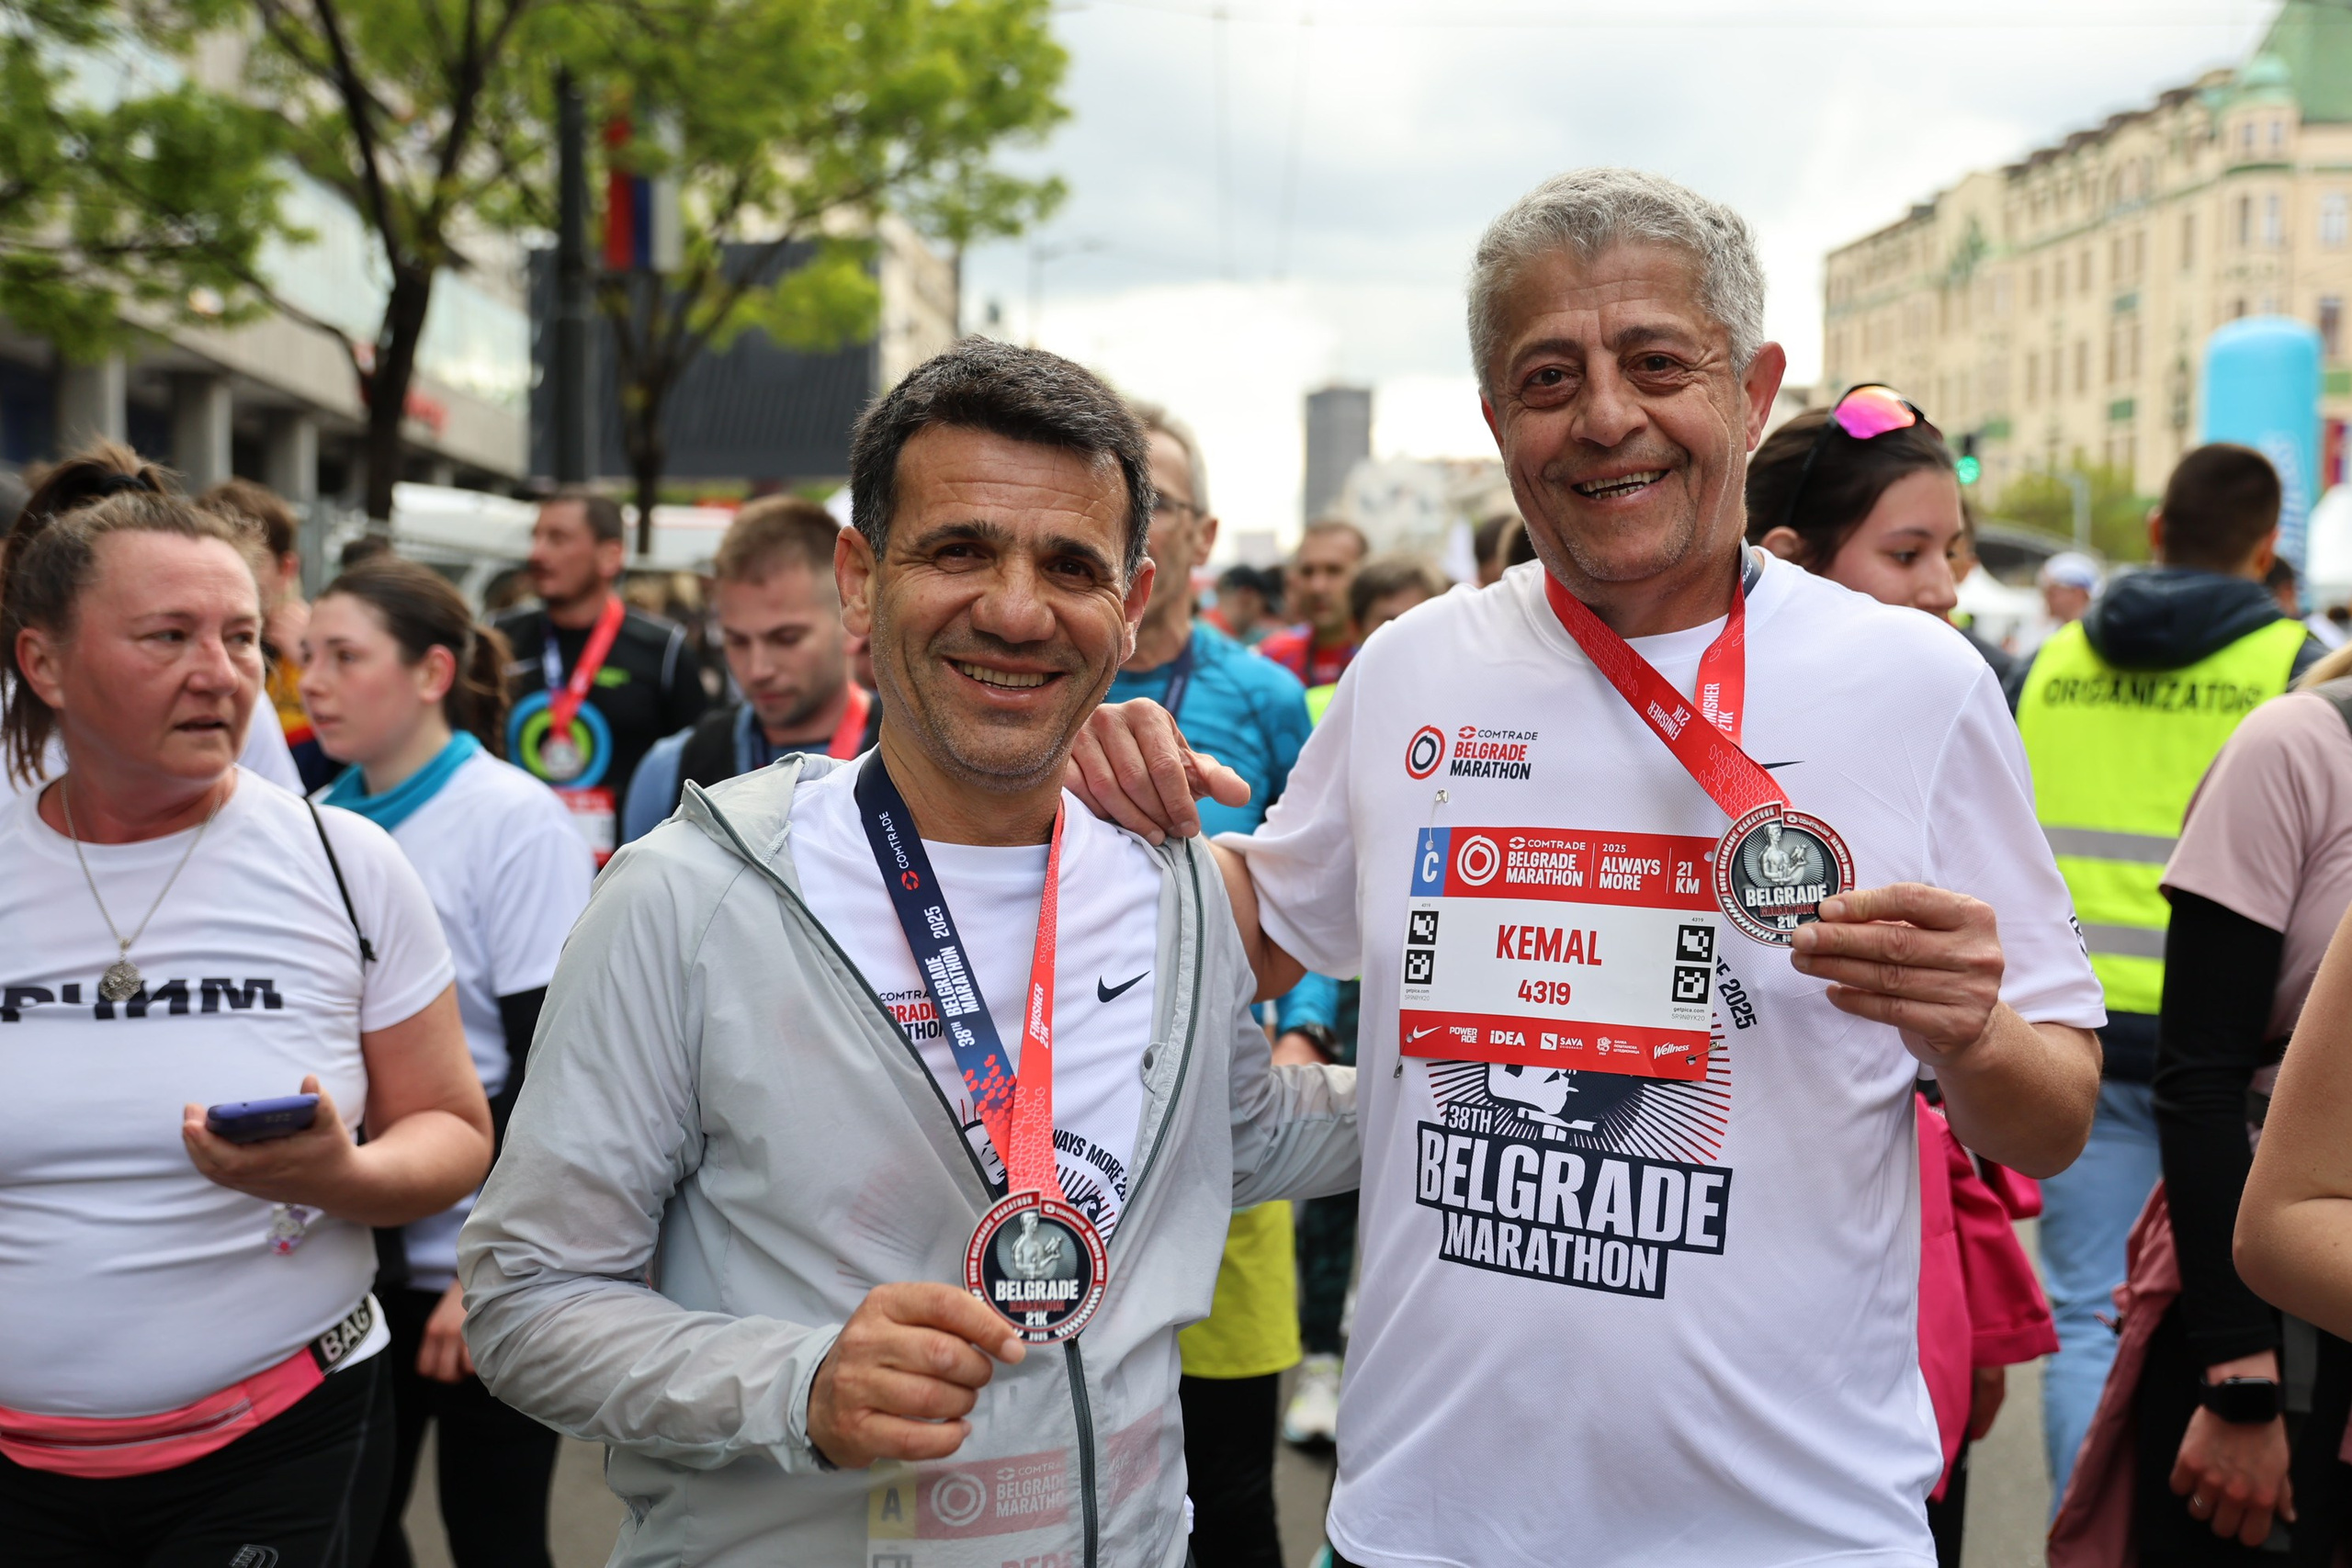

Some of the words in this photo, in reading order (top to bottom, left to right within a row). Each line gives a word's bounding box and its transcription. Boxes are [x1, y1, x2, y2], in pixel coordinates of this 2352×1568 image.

[1671, 704, 1691, 728] 21K
[1702, 682, 1720, 727] NISHER
[1646, 700, 1681, 741] FINISHER
[1717, 712, 1734, 731] 21K
[1477, 729, 1539, 741] COMTRADE
[1453, 741, 1528, 761] BELGRADE
[1450, 760, 1532, 780] MARATHON
[879, 811, 909, 869] COMTRADE
[1527, 839, 1587, 851] COMTRADE
[1602, 843, 1626, 853] 2025
[1421, 851, 1440, 883] C
[1507, 852, 1577, 870] BELGRADE
[1600, 856, 1660, 875] ALWAYS
[1677, 862, 1692, 876] 21
[1505, 868, 1583, 887] MARATHON
[1599, 873, 1641, 891] MORE
[1675, 878, 1700, 894] KM
[1746, 884, 1827, 907] BELGRADE
[923, 906, 950, 939] 2025
[1778, 915, 1799, 929] 21K
[1496, 924, 1602, 966] KEMAL
[924, 955, 963, 1018] BELGRADE
[939, 945, 979, 1014] MARATHON
[879, 989, 930, 1002] COMTRA
[1518, 979, 1571, 1006] 4319
[1718, 978, 1757, 1030] 2025
[1029, 982, 1044, 1041] FINISHER
[950, 1021, 976, 1047] 38TH
[1449, 1026, 1477, 1036] POWER
[1461, 1035, 1477, 1043] ADE
[1560, 1036, 1583, 1046] SAVA
[1654, 1042, 1690, 1060] Wellness
[1448, 1105, 1493, 1134] 38TH
[1052, 1129, 1087, 1156] WAYS
[1085, 1144, 1125, 1184] MORE
[1419, 1128, 1724, 1248] BELGRADE
[1443, 1211, 1659, 1292] MARATHON
[995, 1280, 1079, 1302] BELGRADE
[1025, 1311, 1047, 1325] 21K
[319, 1303, 371, 1363] BAG
[996, 1473, 1066, 1500] BELGRAD
[880, 1487, 903, 1523] A
[996, 1491, 1065, 1517] MARATHO
